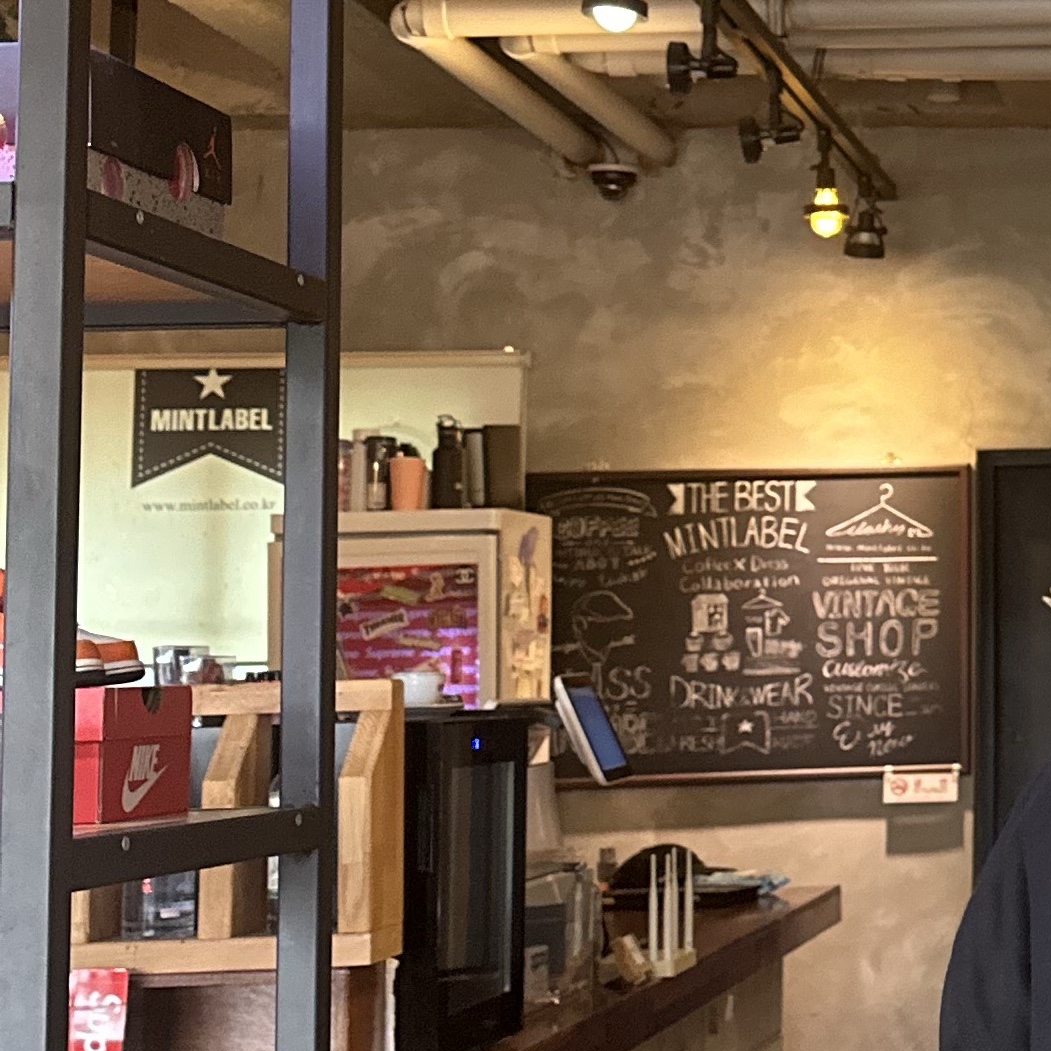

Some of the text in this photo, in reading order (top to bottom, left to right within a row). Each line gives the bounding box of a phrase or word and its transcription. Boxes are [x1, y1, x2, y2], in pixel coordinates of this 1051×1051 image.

[150, 407, 273, 432] MINTLABEL
[687, 480, 795, 514] THE BEST
[663, 515, 810, 560] MINTLABEL
[815, 618, 938, 658] SHOP
[669, 675, 736, 710] DRINK
[750, 672, 815, 707] WEAR
[826, 692, 904, 720] SINCE
[129, 744, 161, 781] NIKE
